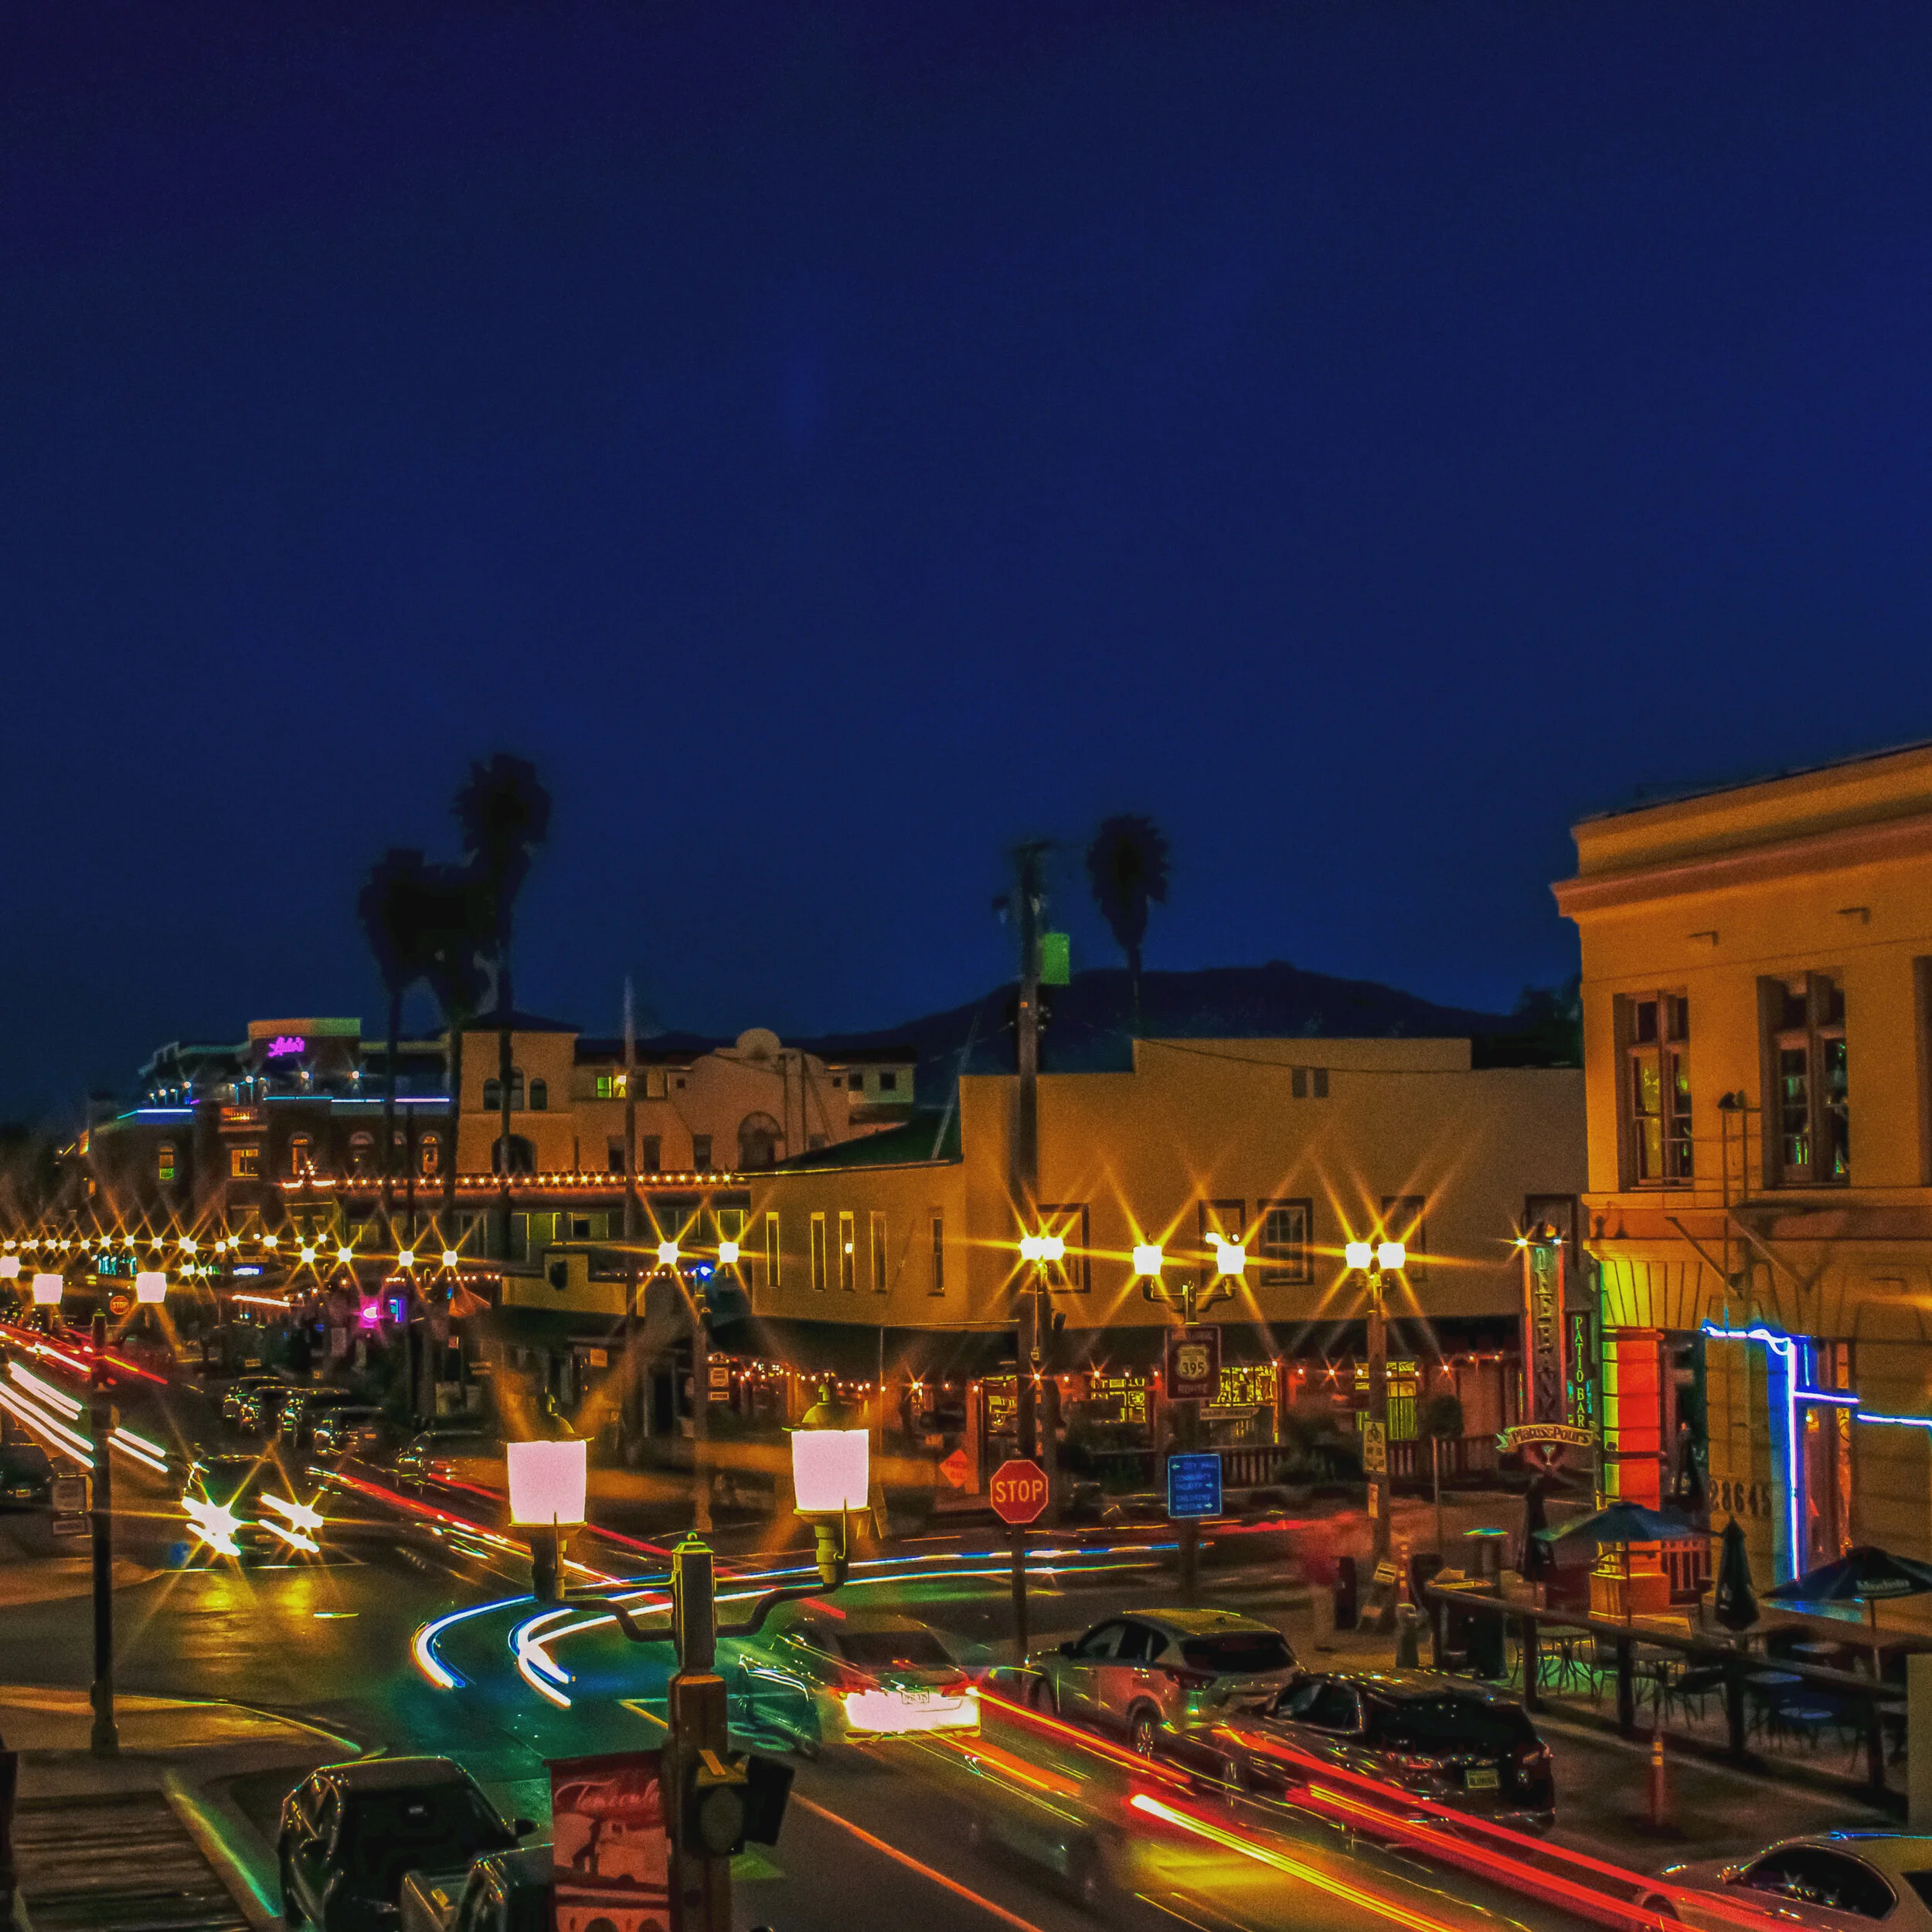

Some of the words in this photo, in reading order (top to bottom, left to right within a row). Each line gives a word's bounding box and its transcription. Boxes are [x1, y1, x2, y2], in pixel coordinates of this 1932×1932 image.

[111, 1301, 128, 1311] STOP
[1574, 1316, 1584, 1383] PATIO
[1182, 1361, 1206, 1376] 395
[1577, 1387, 1585, 1427] BAR
[1553, 1427, 1590, 1444] Pours
[995, 1480, 1043, 1502] STOP
